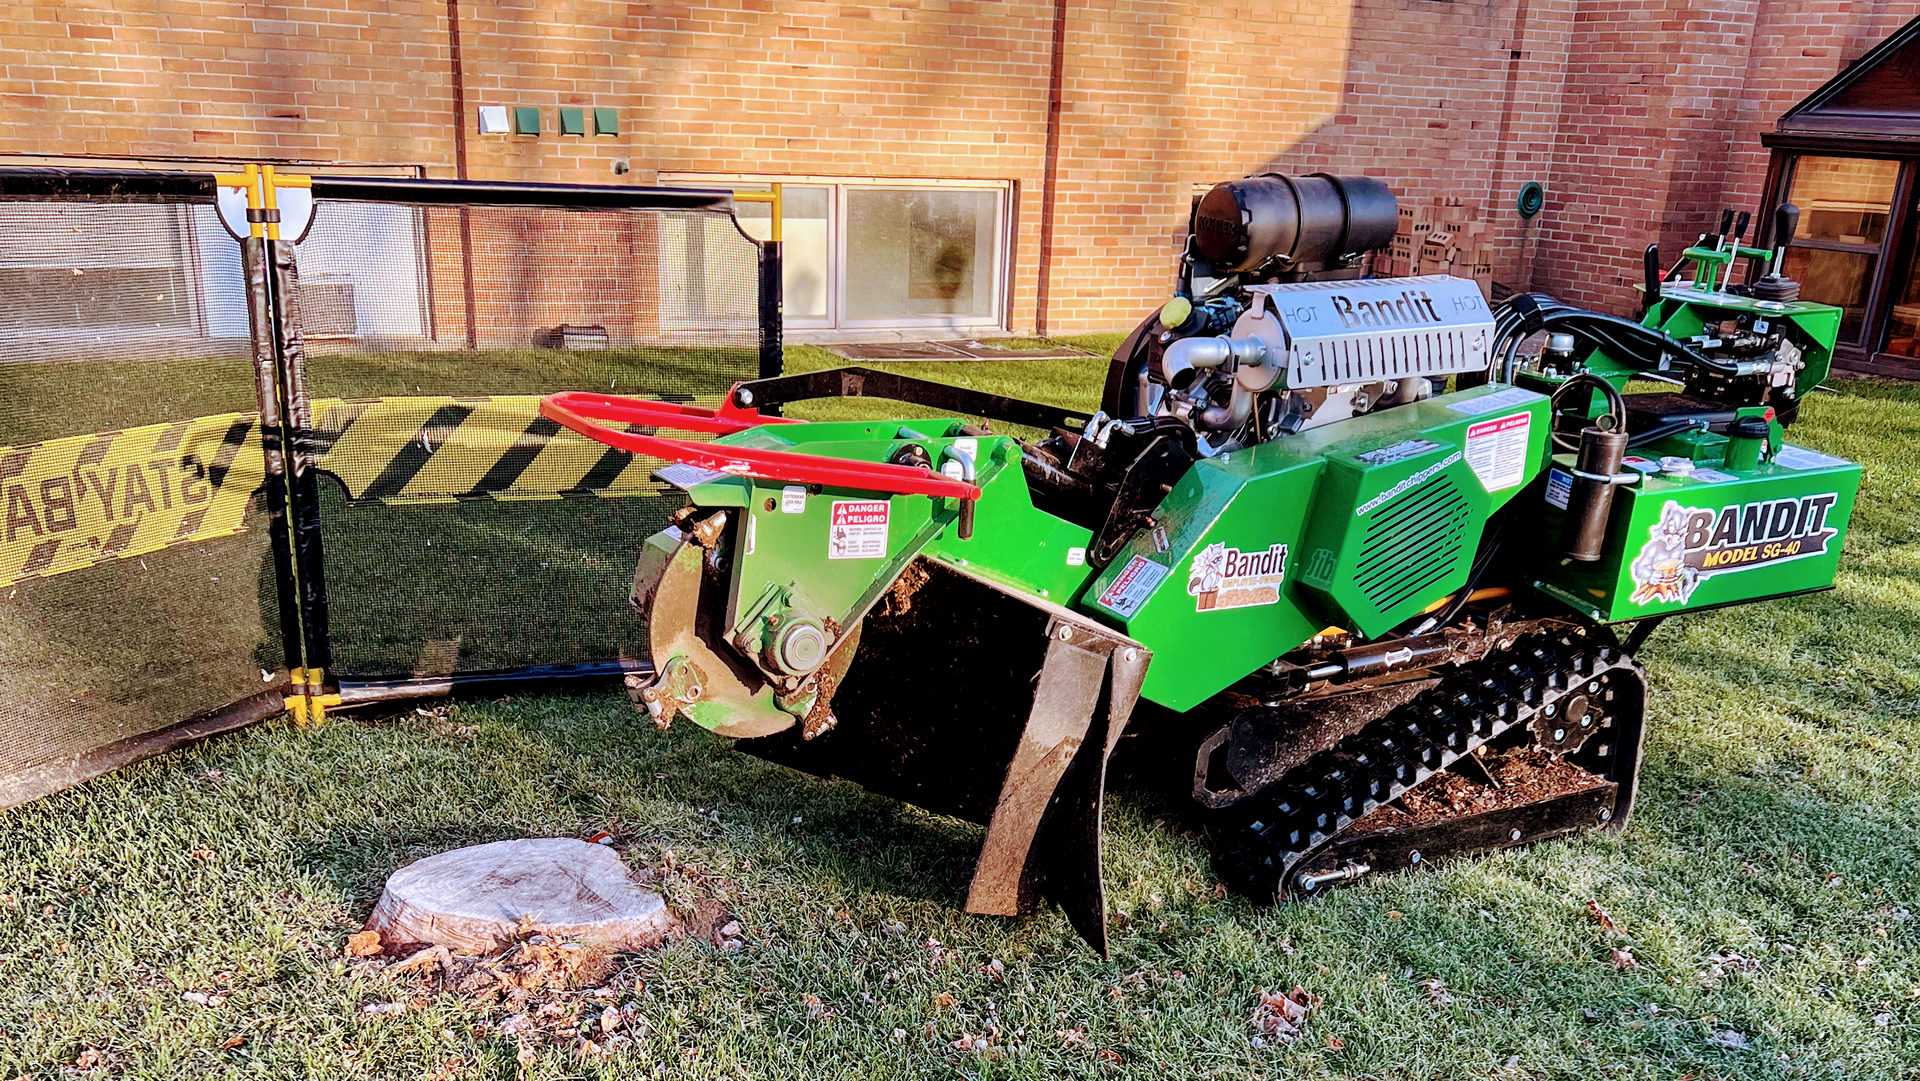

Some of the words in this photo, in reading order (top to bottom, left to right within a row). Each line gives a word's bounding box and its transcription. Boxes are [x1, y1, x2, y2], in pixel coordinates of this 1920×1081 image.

[1198, 215, 1237, 236] KOHLER
[1284, 306, 1318, 324] HOT
[1331, 290, 1442, 329] Bandit
[1452, 295, 1483, 312] HOT
[1476, 424, 1498, 435] DANGER
[1506, 417, 1528, 427] PELIGRO
[1357, 452, 1461, 515] www.banditchippers.com
[847, 514, 886, 523] PELIGRO
[848, 504, 885, 513] DANGER
[1684, 496, 1835, 549] BANDIT
[1225, 546, 1286, 578] Bandit
[1703, 547, 1758, 568] MODEL
[1761, 541, 1801, 560] SG-40
[1116, 561, 1146, 595] PELIGRO
[1222, 574, 1282, 588] EMPLOYEE-OWNED
